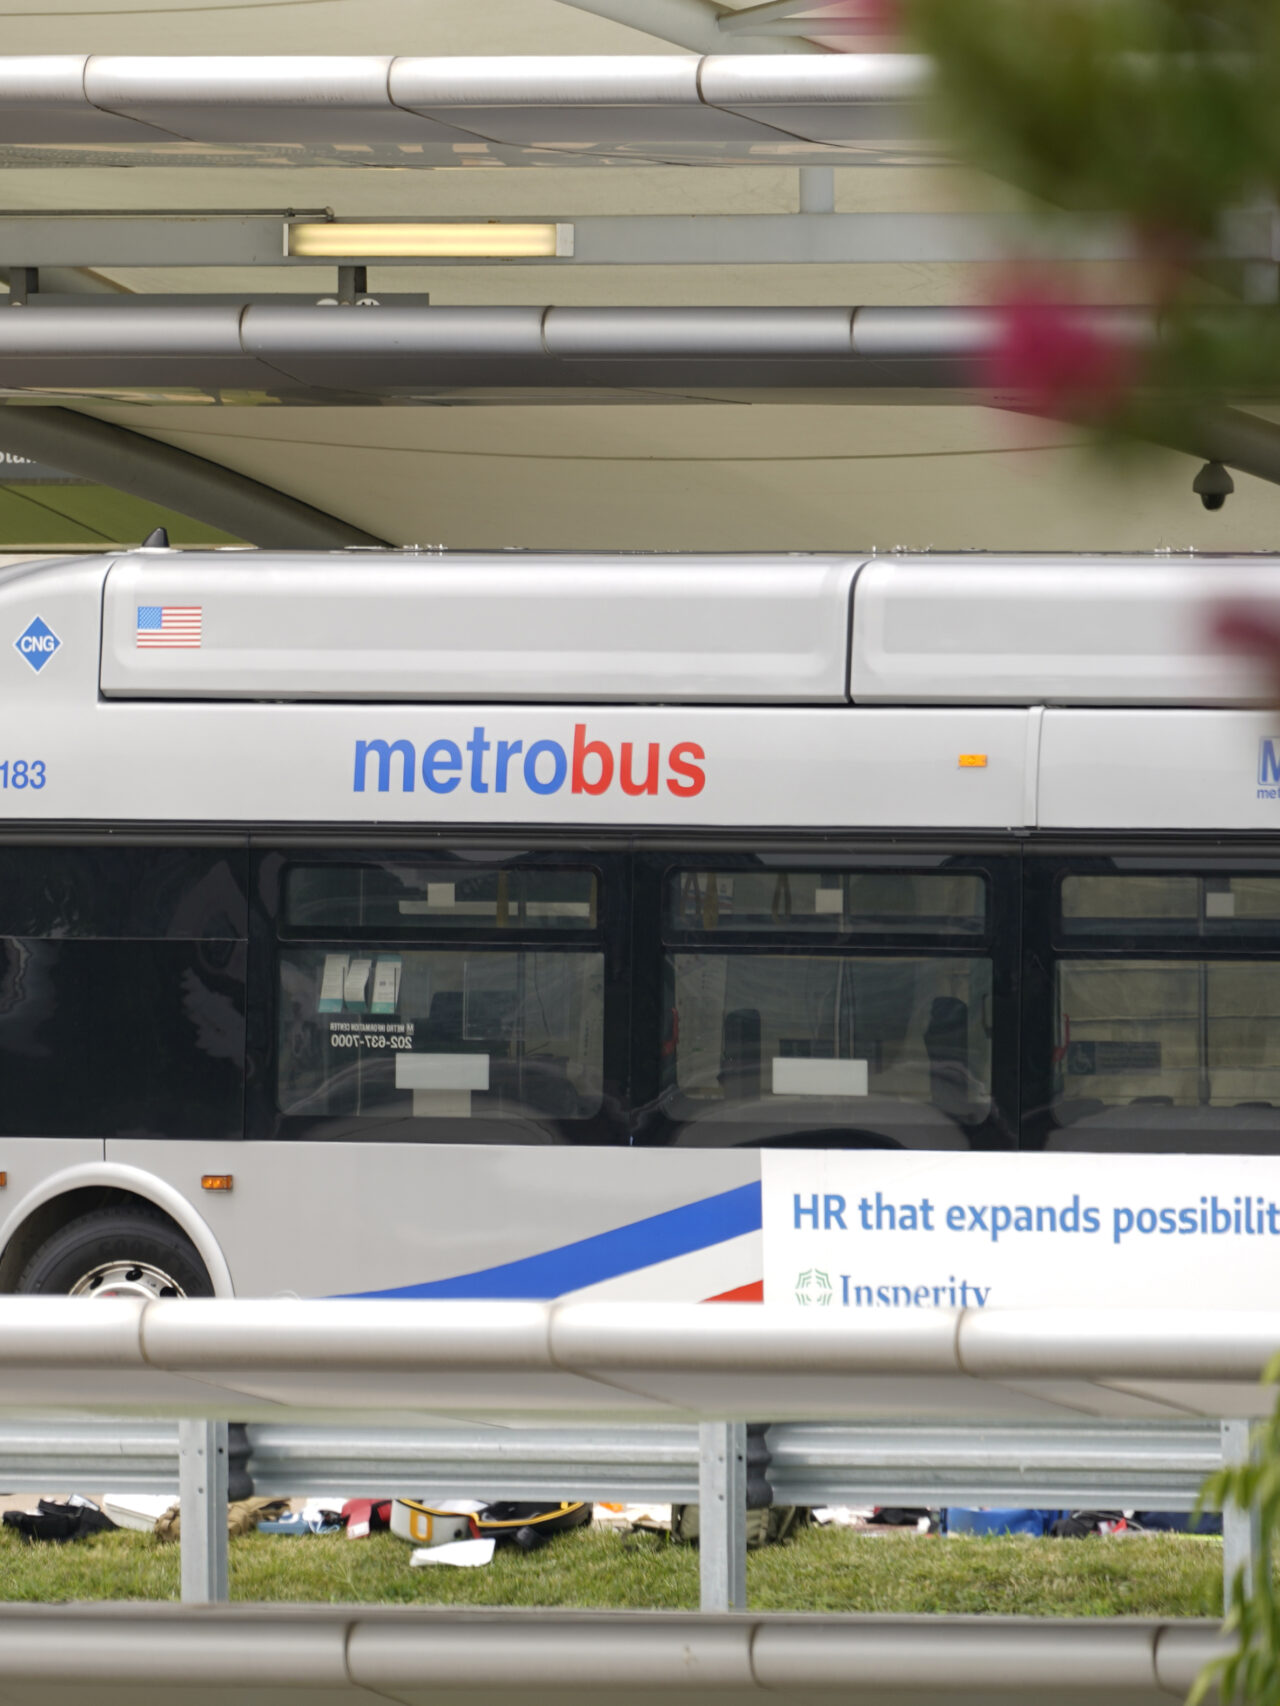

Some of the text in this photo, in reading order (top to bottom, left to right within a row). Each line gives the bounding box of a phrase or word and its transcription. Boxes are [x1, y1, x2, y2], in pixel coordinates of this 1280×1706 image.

[20, 635, 55, 652] CNG
[353, 724, 706, 798] metrobus
[793, 1191, 1280, 1244] HR that expands possibilit
